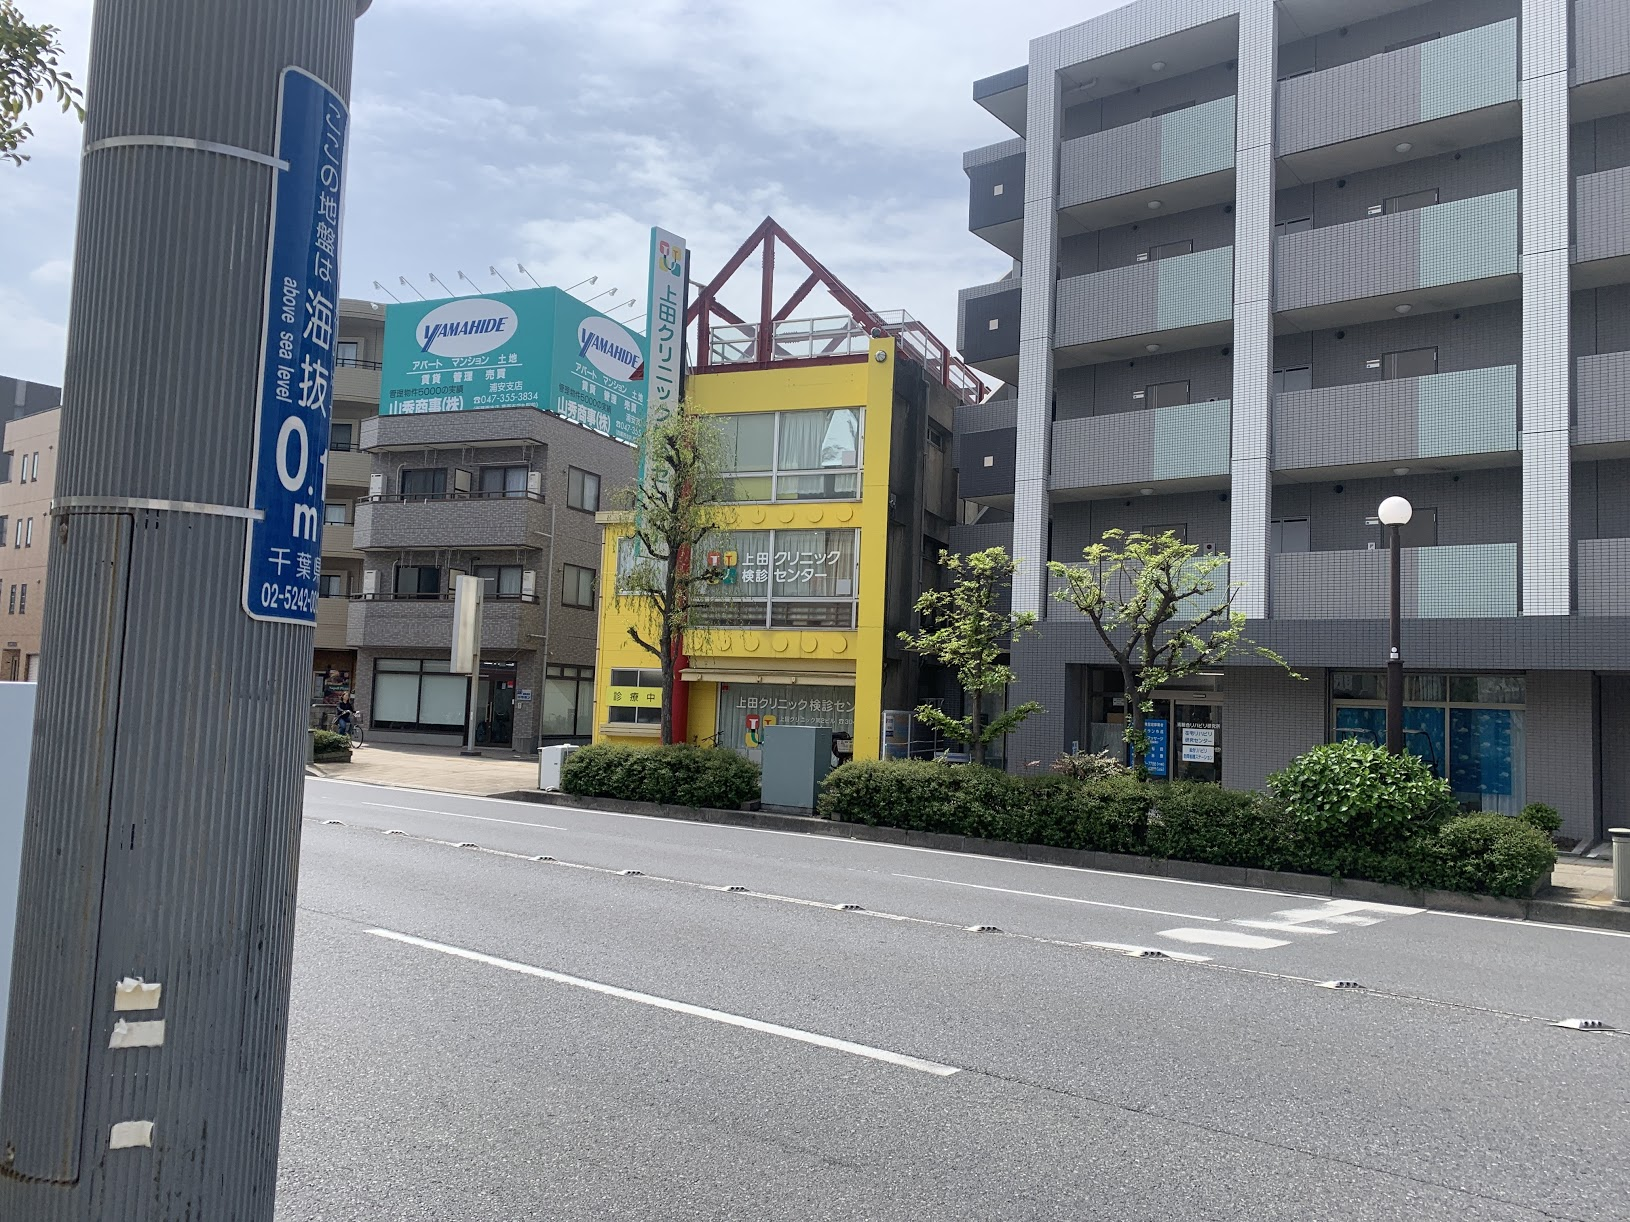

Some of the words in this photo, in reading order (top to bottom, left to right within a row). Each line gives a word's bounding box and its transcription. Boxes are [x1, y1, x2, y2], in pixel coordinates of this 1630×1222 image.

[315, 102, 342, 283] ここの地盤は
[281, 276, 300, 324] above
[279, 331, 294, 360] sea
[421, 316, 509, 353] YAMAHIDE
[578, 327, 640, 369] YAMAHIDE
[298, 288, 333, 418] 海抜
[412, 359, 443, 370] アパート
[451, 356, 490, 367] マンション
[497, 353, 518, 364] 土地
[275, 364, 295, 404] level
[453, 371, 473, 383] 管理
[485, 368, 506, 380] 売買
[489, 380, 523, 393] 浦安支店
[575, 361, 598, 380] アパート
[602, 375, 628, 394] マンション
[557, 395, 611, 435] 山秀商事(株)
[292, 502, 318, 543] m
[268, 546, 321, 582] 千葉県
[741, 550, 841, 567] 上田クリニック
[741, 568, 828, 583] 検診センター
[613, 691, 656, 703] 診療中
